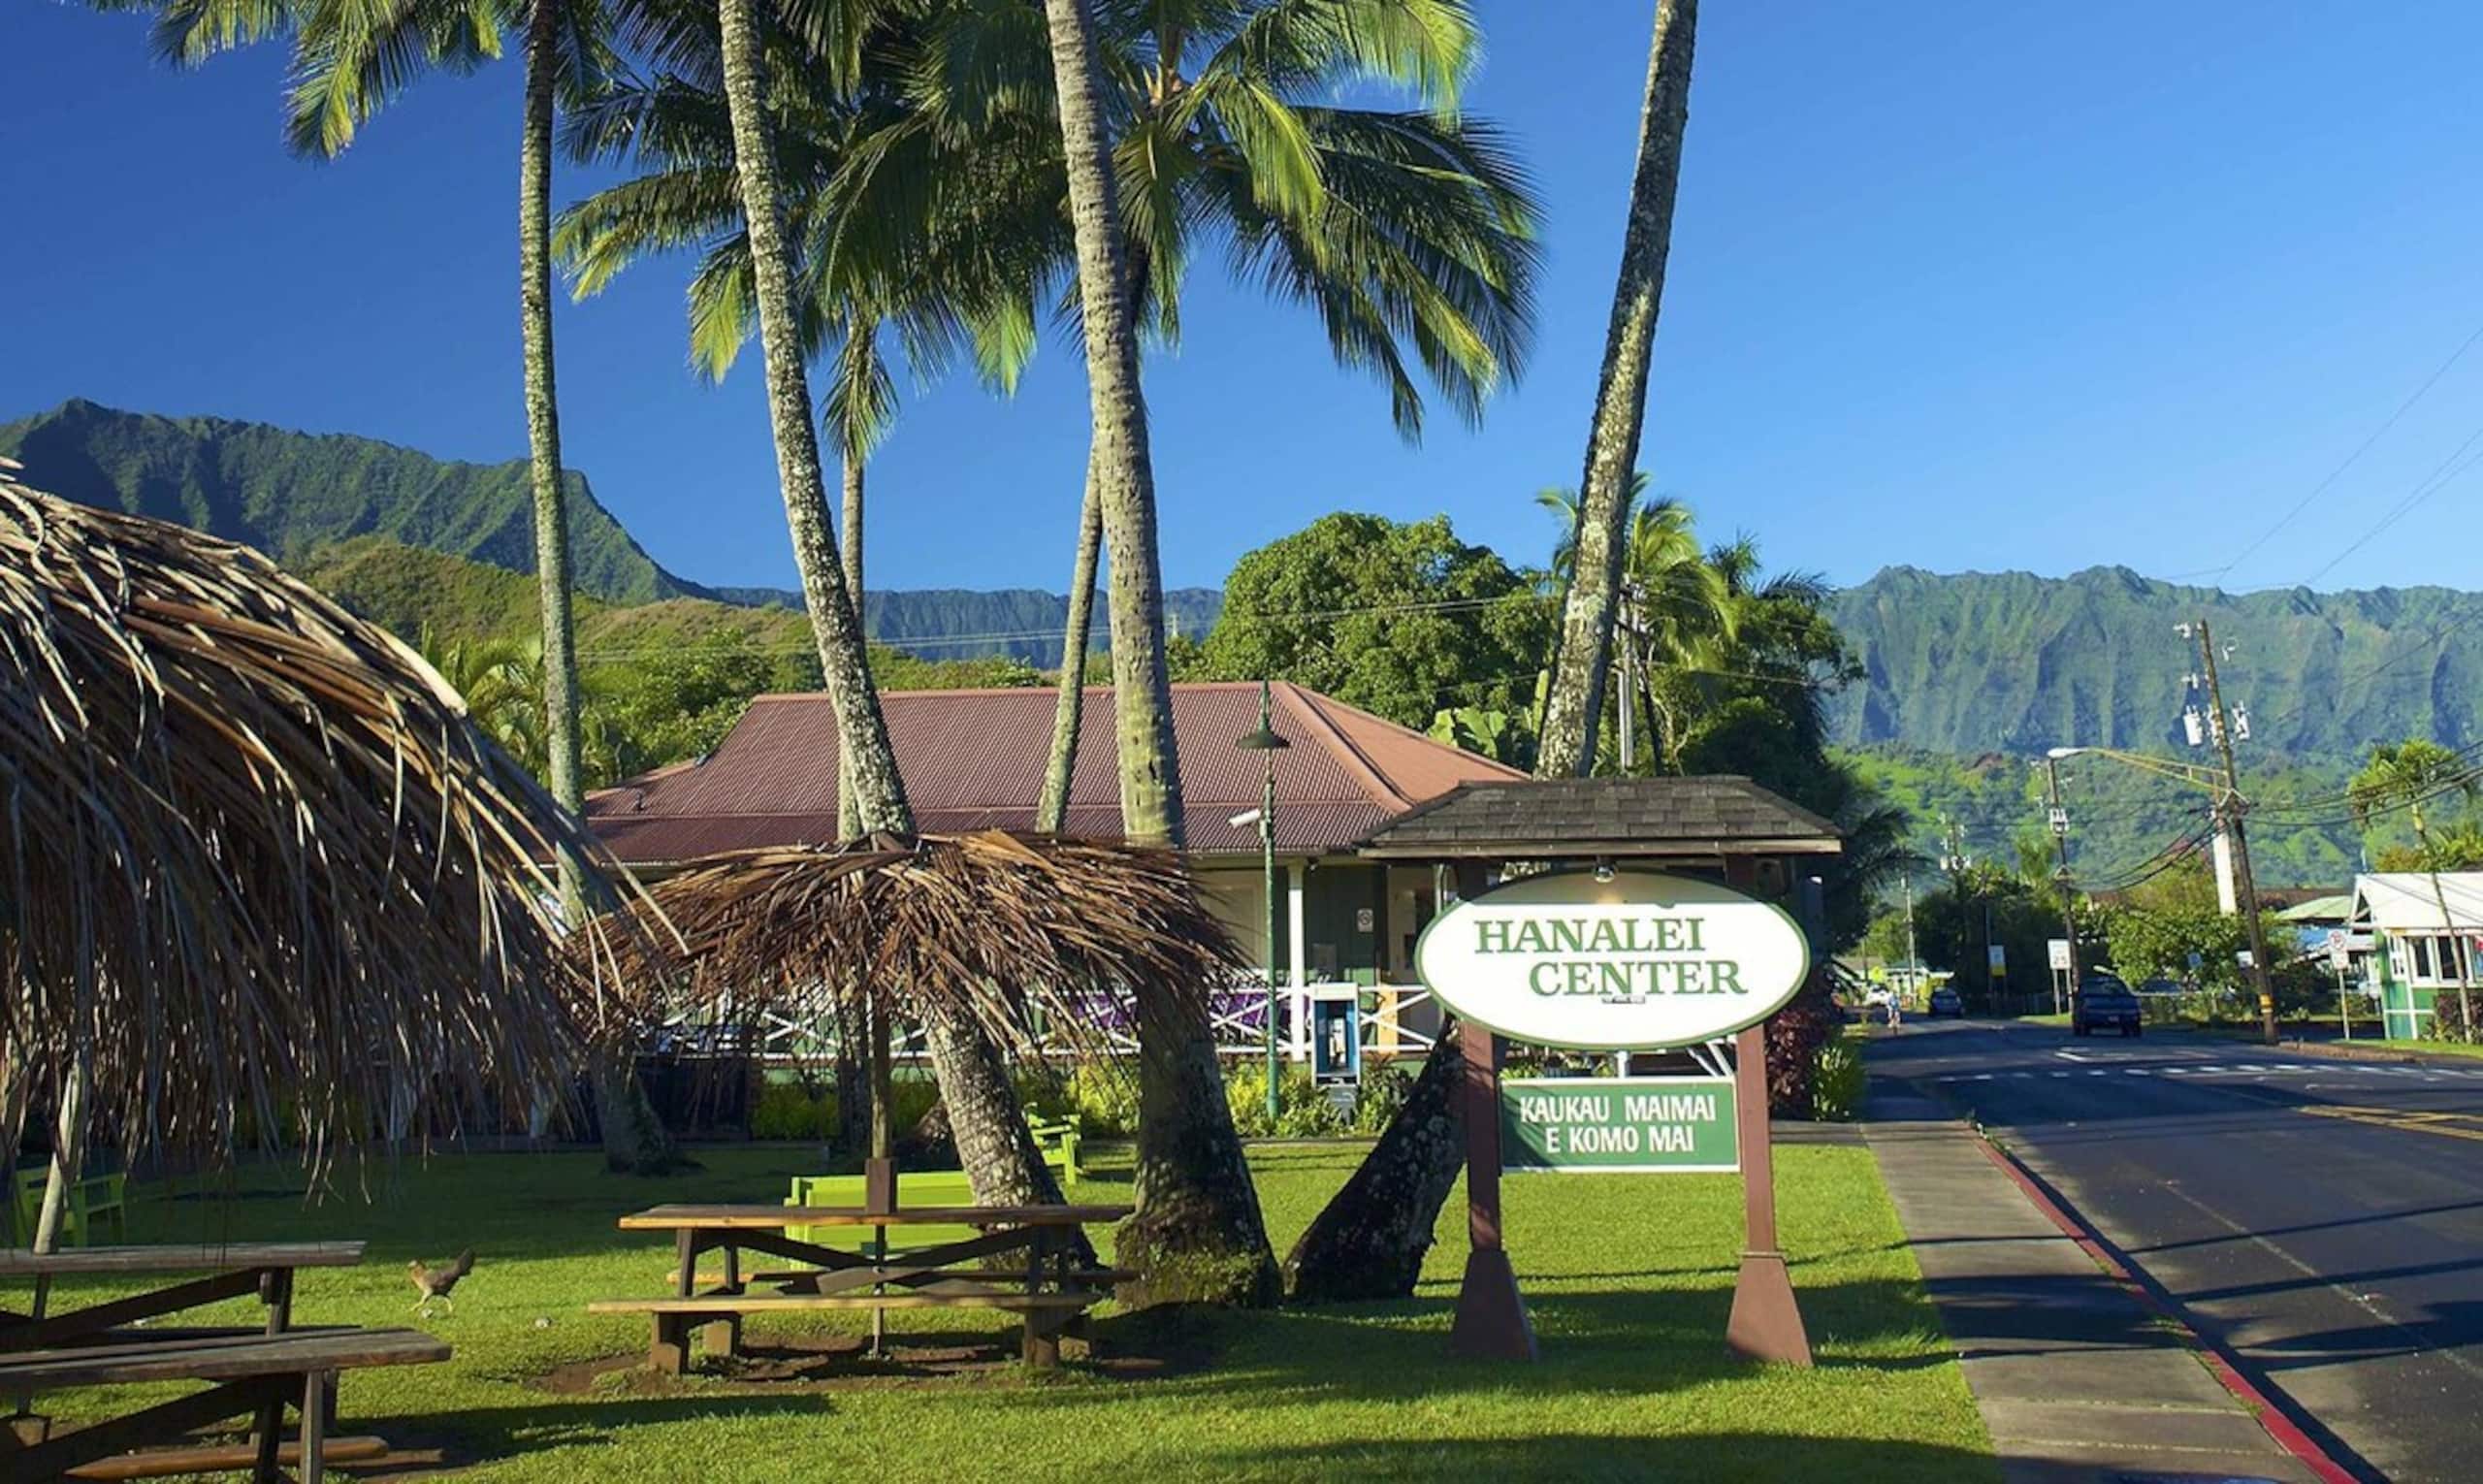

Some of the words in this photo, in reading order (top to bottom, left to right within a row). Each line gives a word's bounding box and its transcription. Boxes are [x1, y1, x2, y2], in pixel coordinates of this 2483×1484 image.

[1474, 918, 1705, 953] HANALEI
[1529, 959, 1749, 996] CENTER
[1519, 1096, 1610, 1123] KAUKAU
[1625, 1095, 1717, 1122] MAIMAI
[1545, 1127, 1561, 1152] E
[1568, 1126, 1639, 1152] KOMO
[1649, 1125, 1694, 1152] MAI
